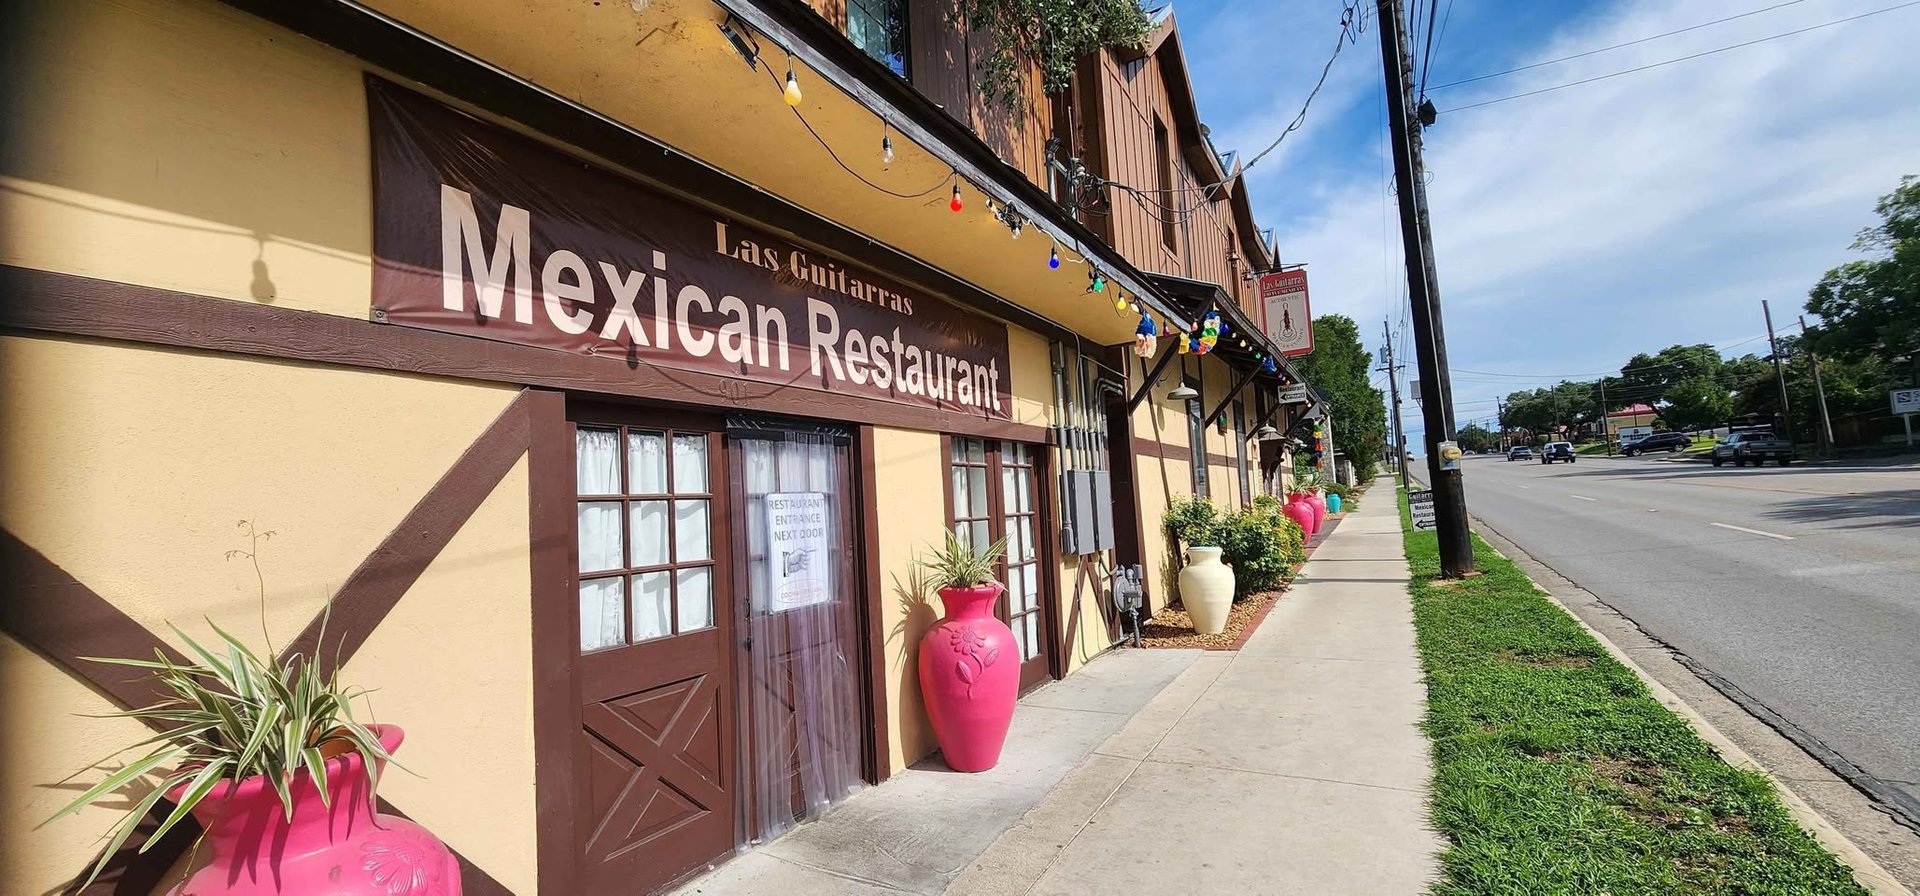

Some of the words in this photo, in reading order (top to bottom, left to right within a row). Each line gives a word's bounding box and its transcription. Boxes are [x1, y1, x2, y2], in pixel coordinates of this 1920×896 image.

[713, 220, 780, 272] Las
[789, 250, 913, 316] Guitarras
[440, 183, 790, 371] Mexican
[806, 297, 1000, 412] Restaurant
[769, 498, 824, 510] RESTAURANT
[775, 513, 821, 525] ENTRANCE
[774, 530, 797, 541] NEXT
[800, 528, 823, 539] DOOR
